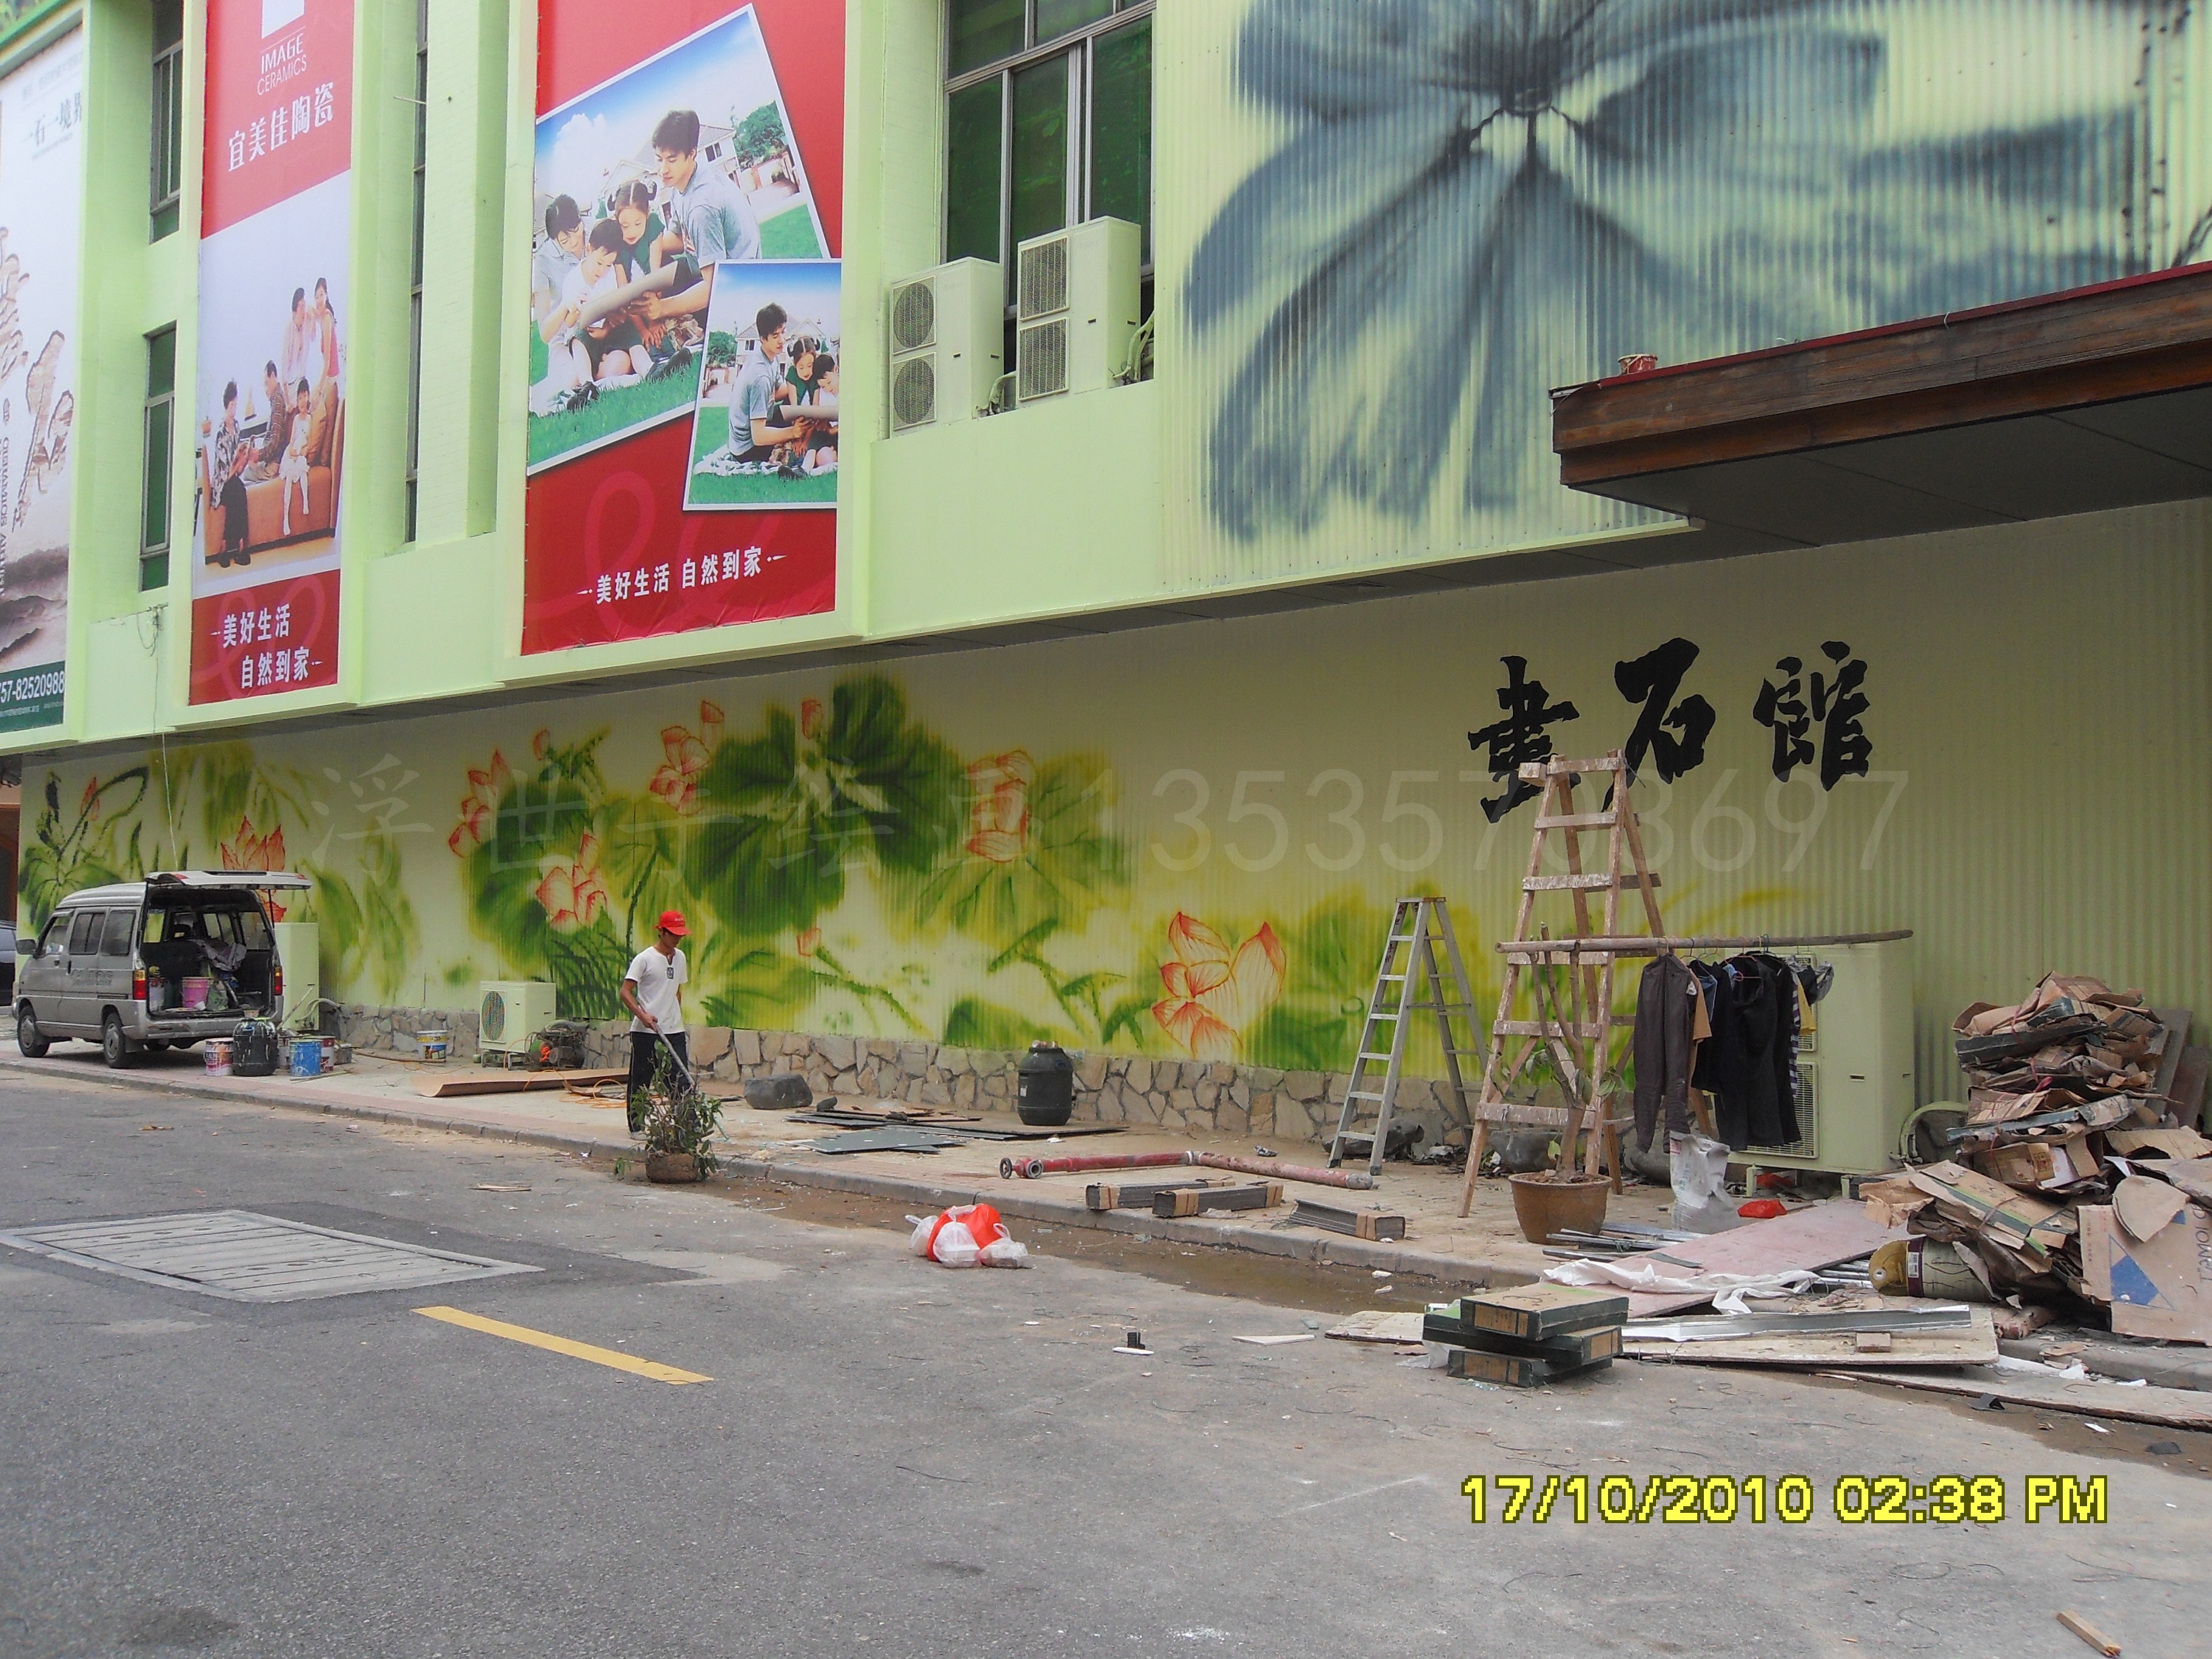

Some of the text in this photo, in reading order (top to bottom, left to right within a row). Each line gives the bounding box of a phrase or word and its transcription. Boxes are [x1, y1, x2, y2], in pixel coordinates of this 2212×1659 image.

[257, 54, 307, 95] CERAMICS
[261, 33, 304, 75] IMAGE
[229, 82, 334, 172] 宜美佳陶瓷
[596, 546, 762, 605] 美好生活 自然到家
[223, 603, 292, 649] 美好生活
[0, 671, 65, 703] 57-82520988
[241, 646, 310, 689] 自然到家
